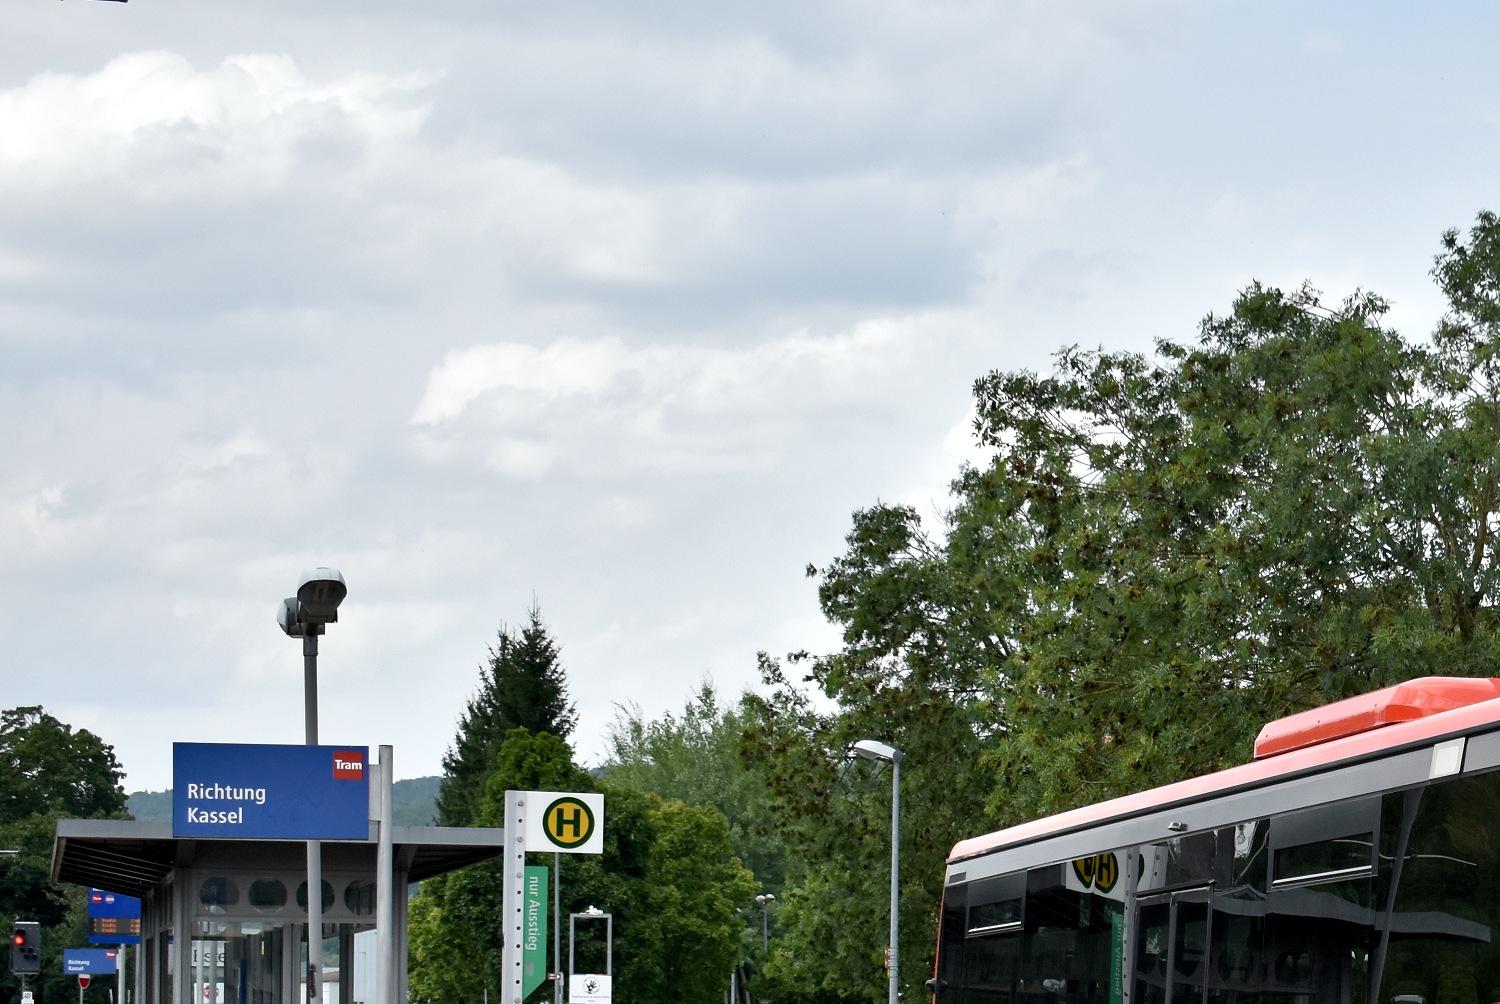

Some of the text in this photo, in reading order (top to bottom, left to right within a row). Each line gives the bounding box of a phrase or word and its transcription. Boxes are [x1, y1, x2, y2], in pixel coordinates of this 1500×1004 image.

[334, 759, 363, 771] Tram
[187, 782, 267, 805] Richtung
[187, 807, 244, 824] Kassel
[556, 807, 581, 837] H
[525, 876, 541, 951] nur Ausstieg
[67, 959, 90, 967] Richtung
